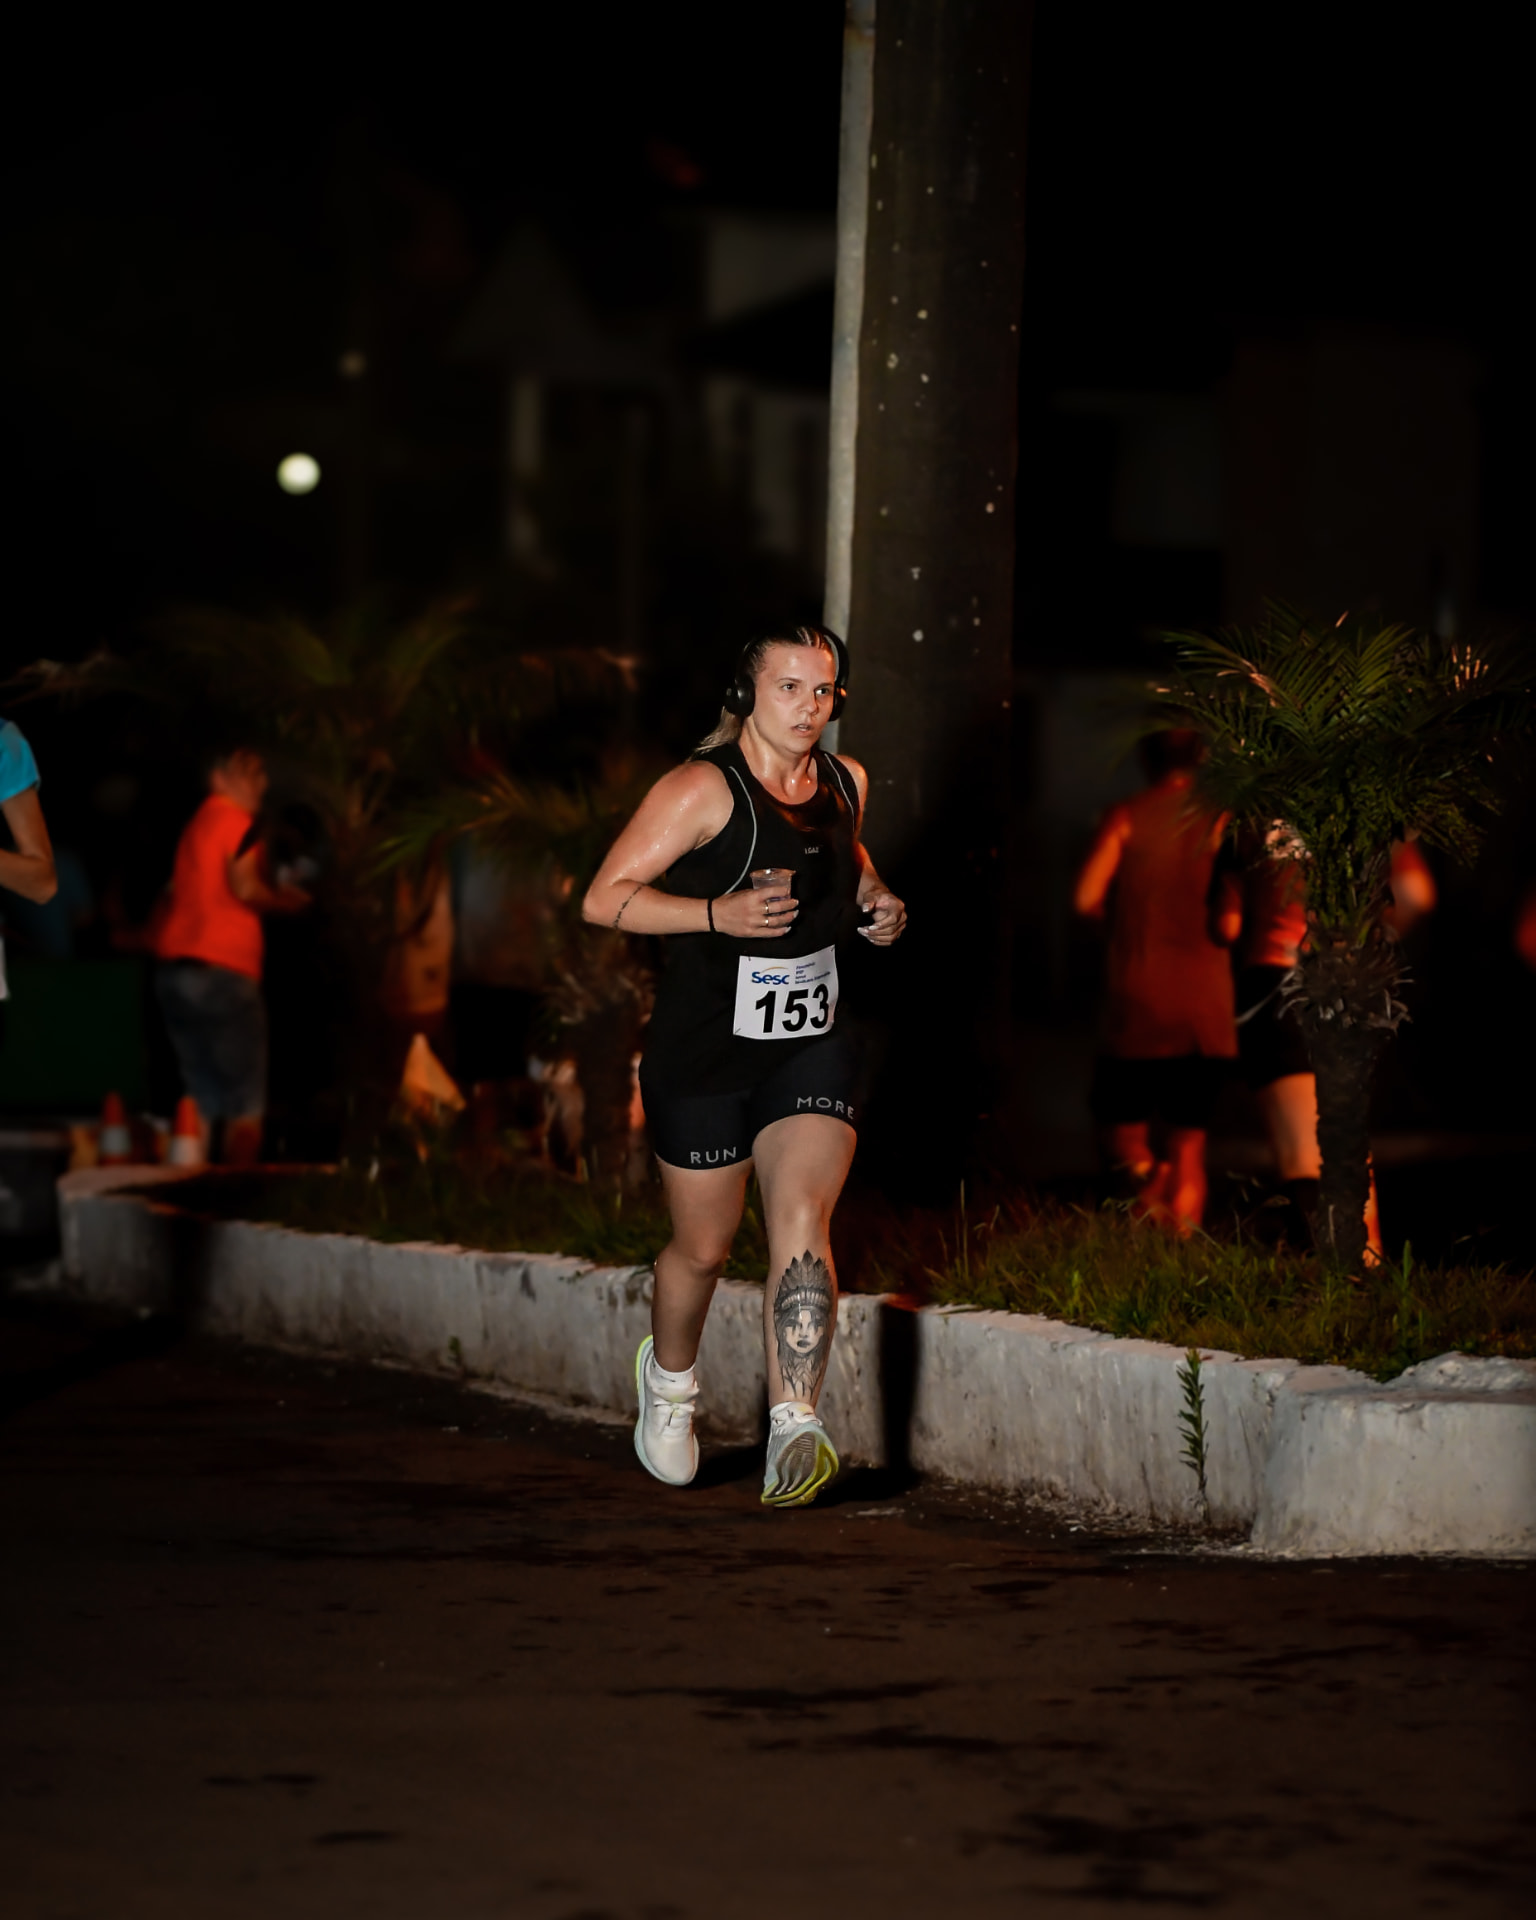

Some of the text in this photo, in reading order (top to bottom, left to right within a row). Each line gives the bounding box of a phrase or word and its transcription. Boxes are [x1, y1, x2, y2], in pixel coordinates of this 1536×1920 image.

[752, 971, 790, 985] Sesc
[755, 983, 829, 1033] 153
[796, 1096, 855, 1119] MORE
[690, 1147, 737, 1164] RUN
